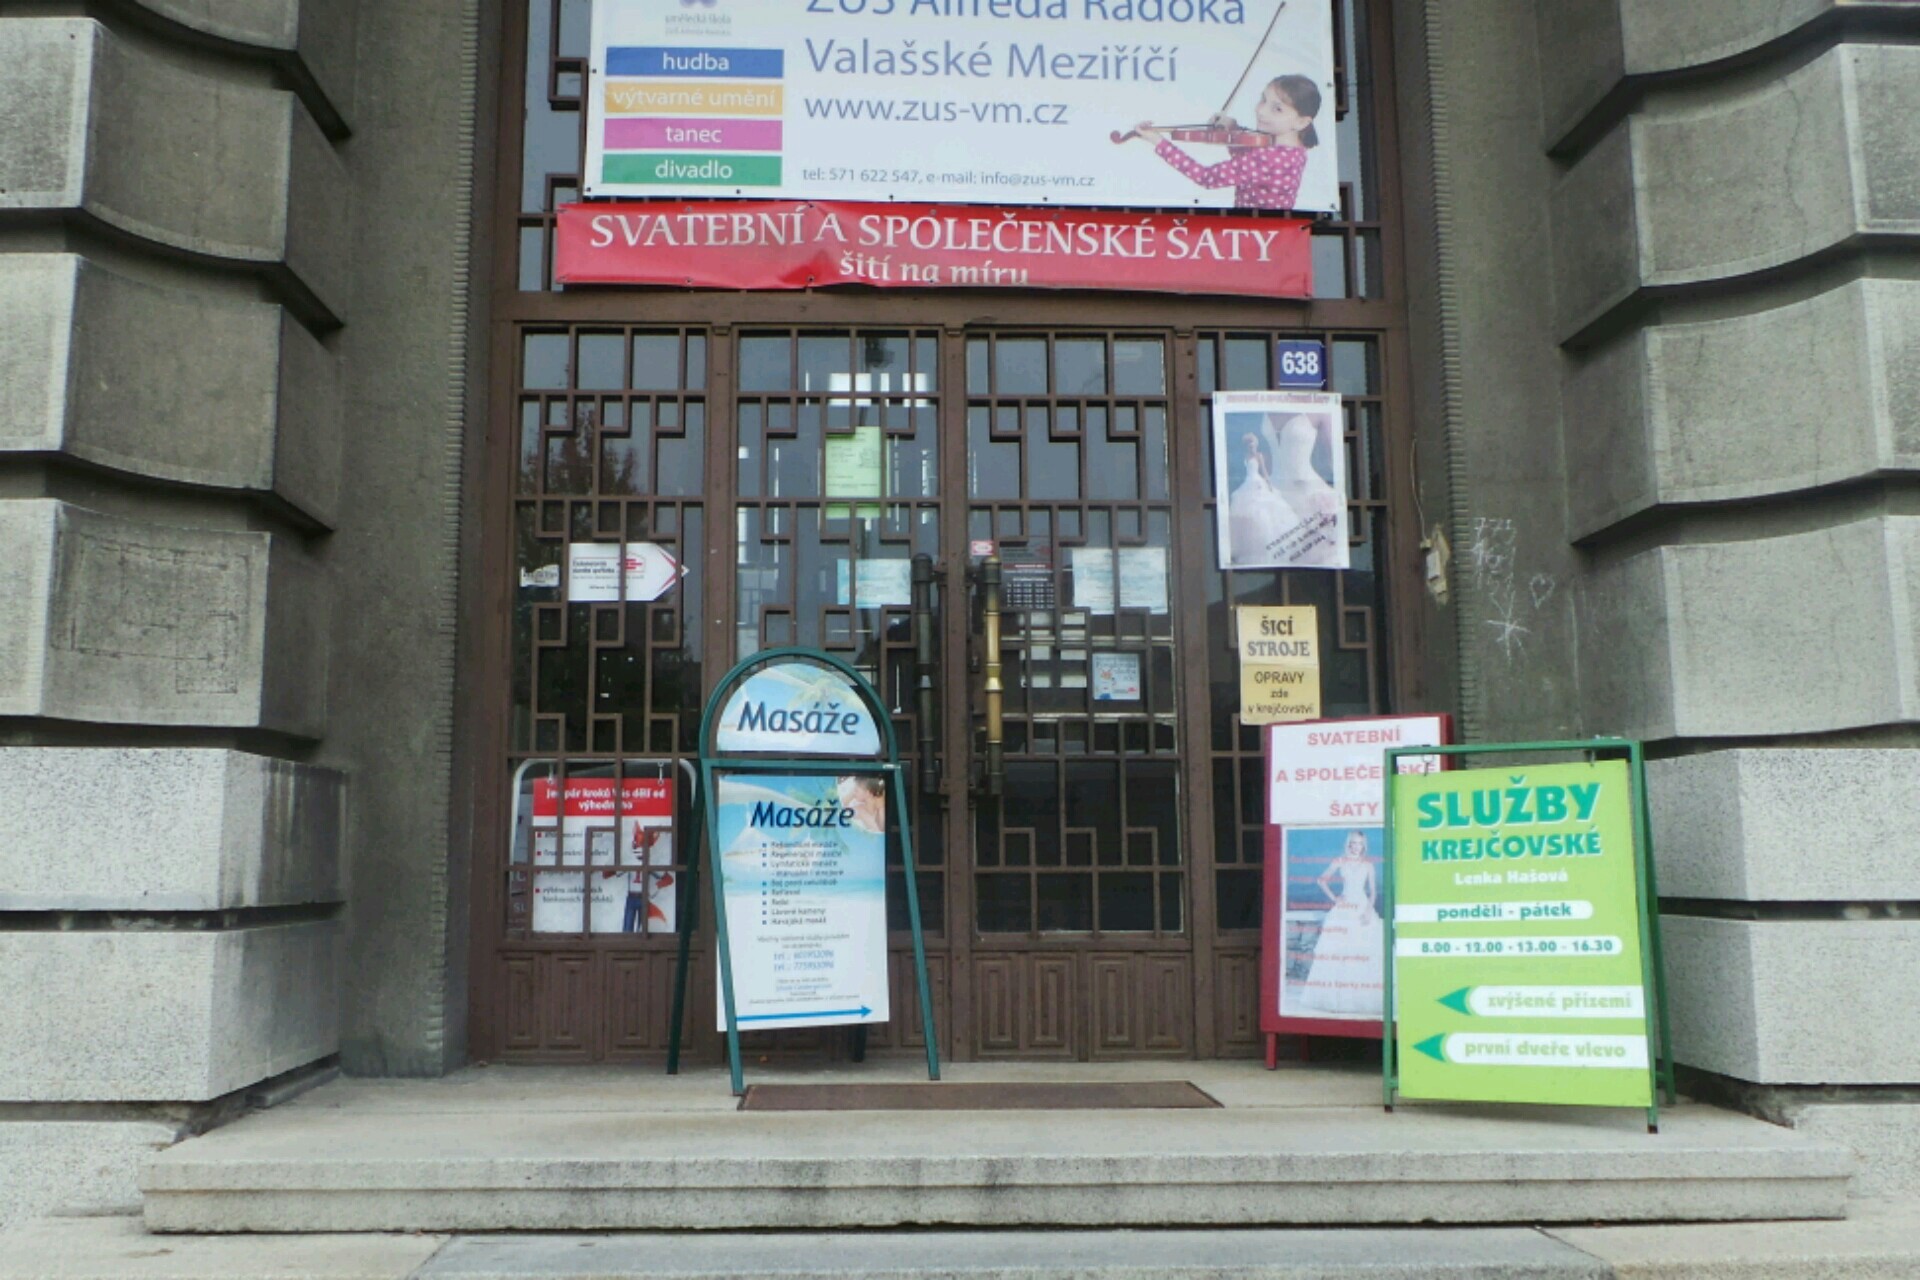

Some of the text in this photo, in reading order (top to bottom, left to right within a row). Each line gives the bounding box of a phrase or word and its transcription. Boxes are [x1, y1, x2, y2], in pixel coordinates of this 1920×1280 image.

[1082, 0, 1246, 24] Radoka
[662, 52, 730, 71] hudba
[805, 38, 1178, 82] Valašské Meziříčí
[612, 87, 776, 109] výtvarné umění
[804, 98, 1069, 126] www.zus-vm.cz
[665, 126, 722, 143] tanec
[655, 160, 733, 179] divadlo
[802, 168, 1096, 187] tel: 571 622 547, e-mail: info@zus-vm.cz
[590, 205, 1279, 262] SVATEBNÍ A SPOLEČENSKÉ ŠATY
[840, 250, 1028, 285] šití na míru
[1282, 351, 1318, 374] 638
[1261, 616, 1293, 636] ŠICÍ
[1248, 641, 1310, 657] STROJE
[1254, 671, 1304, 684] OPRAVY
[737, 701, 860, 735] Masáže
[1308, 727, 1401, 746] SVATEBNÍ
[1276, 770, 1288, 783] A
[1329, 799, 1379, 817] ŠATY
[1417, 775, 1602, 830] SLUŽBY
[751, 800, 855, 828] Masáže
[1421, 826, 1603, 862] KREJČOVSKÉ
[1454, 867, 1569, 886] Lenka Hašová
[1520, 902, 1572, 920] pátek
[1421, 942, 1451, 953] 8.00
[1466, 941, 1503, 953] 12.00
[1518, 940, 1557, 952] 13.00
[1562, 992, 1632, 1010] přízemí
[1465, 1039, 1626, 1058] první dveře vlevo
